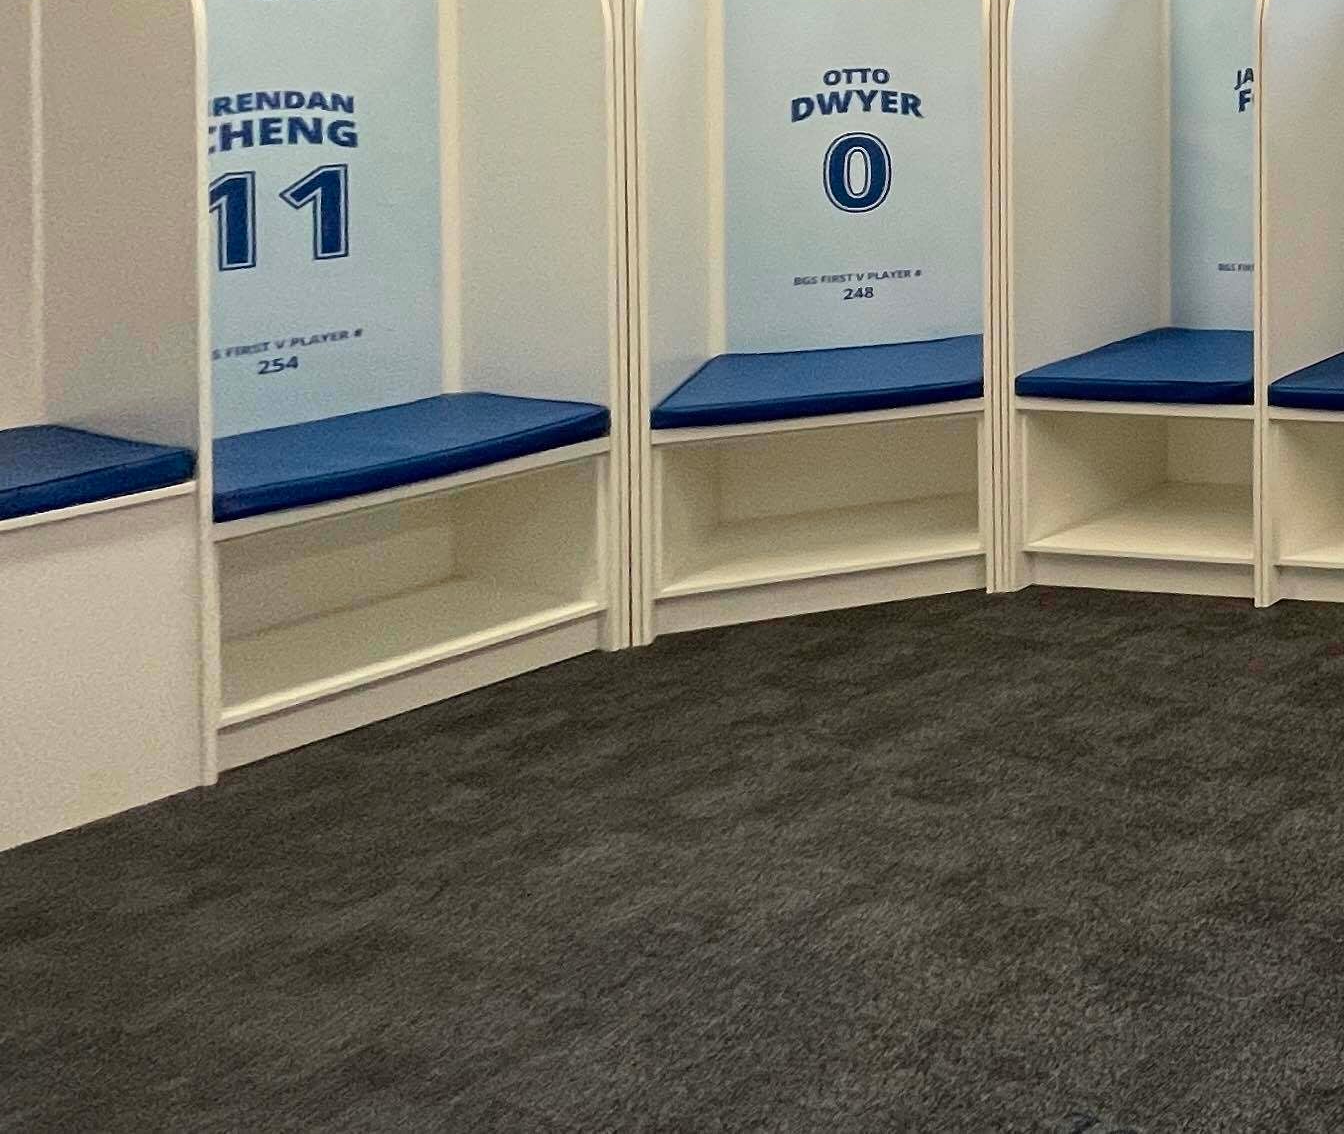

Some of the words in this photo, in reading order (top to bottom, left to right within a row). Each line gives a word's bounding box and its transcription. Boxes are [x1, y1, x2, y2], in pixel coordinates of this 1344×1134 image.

[823, 67, 891, 86] OTTO
[209, 91, 354, 115] RENDAN
[791, 89, 925, 122] DWYER
[1239, 88, 1254, 113] F
[822, 131, 892, 214] 0
[209, 164, 349, 271] 11
[793, 276, 817, 286] BGS
[821, 273, 852, 283] FIRST
[856, 273, 865, 282] V
[867, 269, 911, 280] PLAYER
[843, 287, 874, 300] 248
[225, 342, 270, 357] FIRST
[274, 340, 286, 349] V
[290, 330, 349, 347] PLAYER
[258, 356, 299, 374] 254
